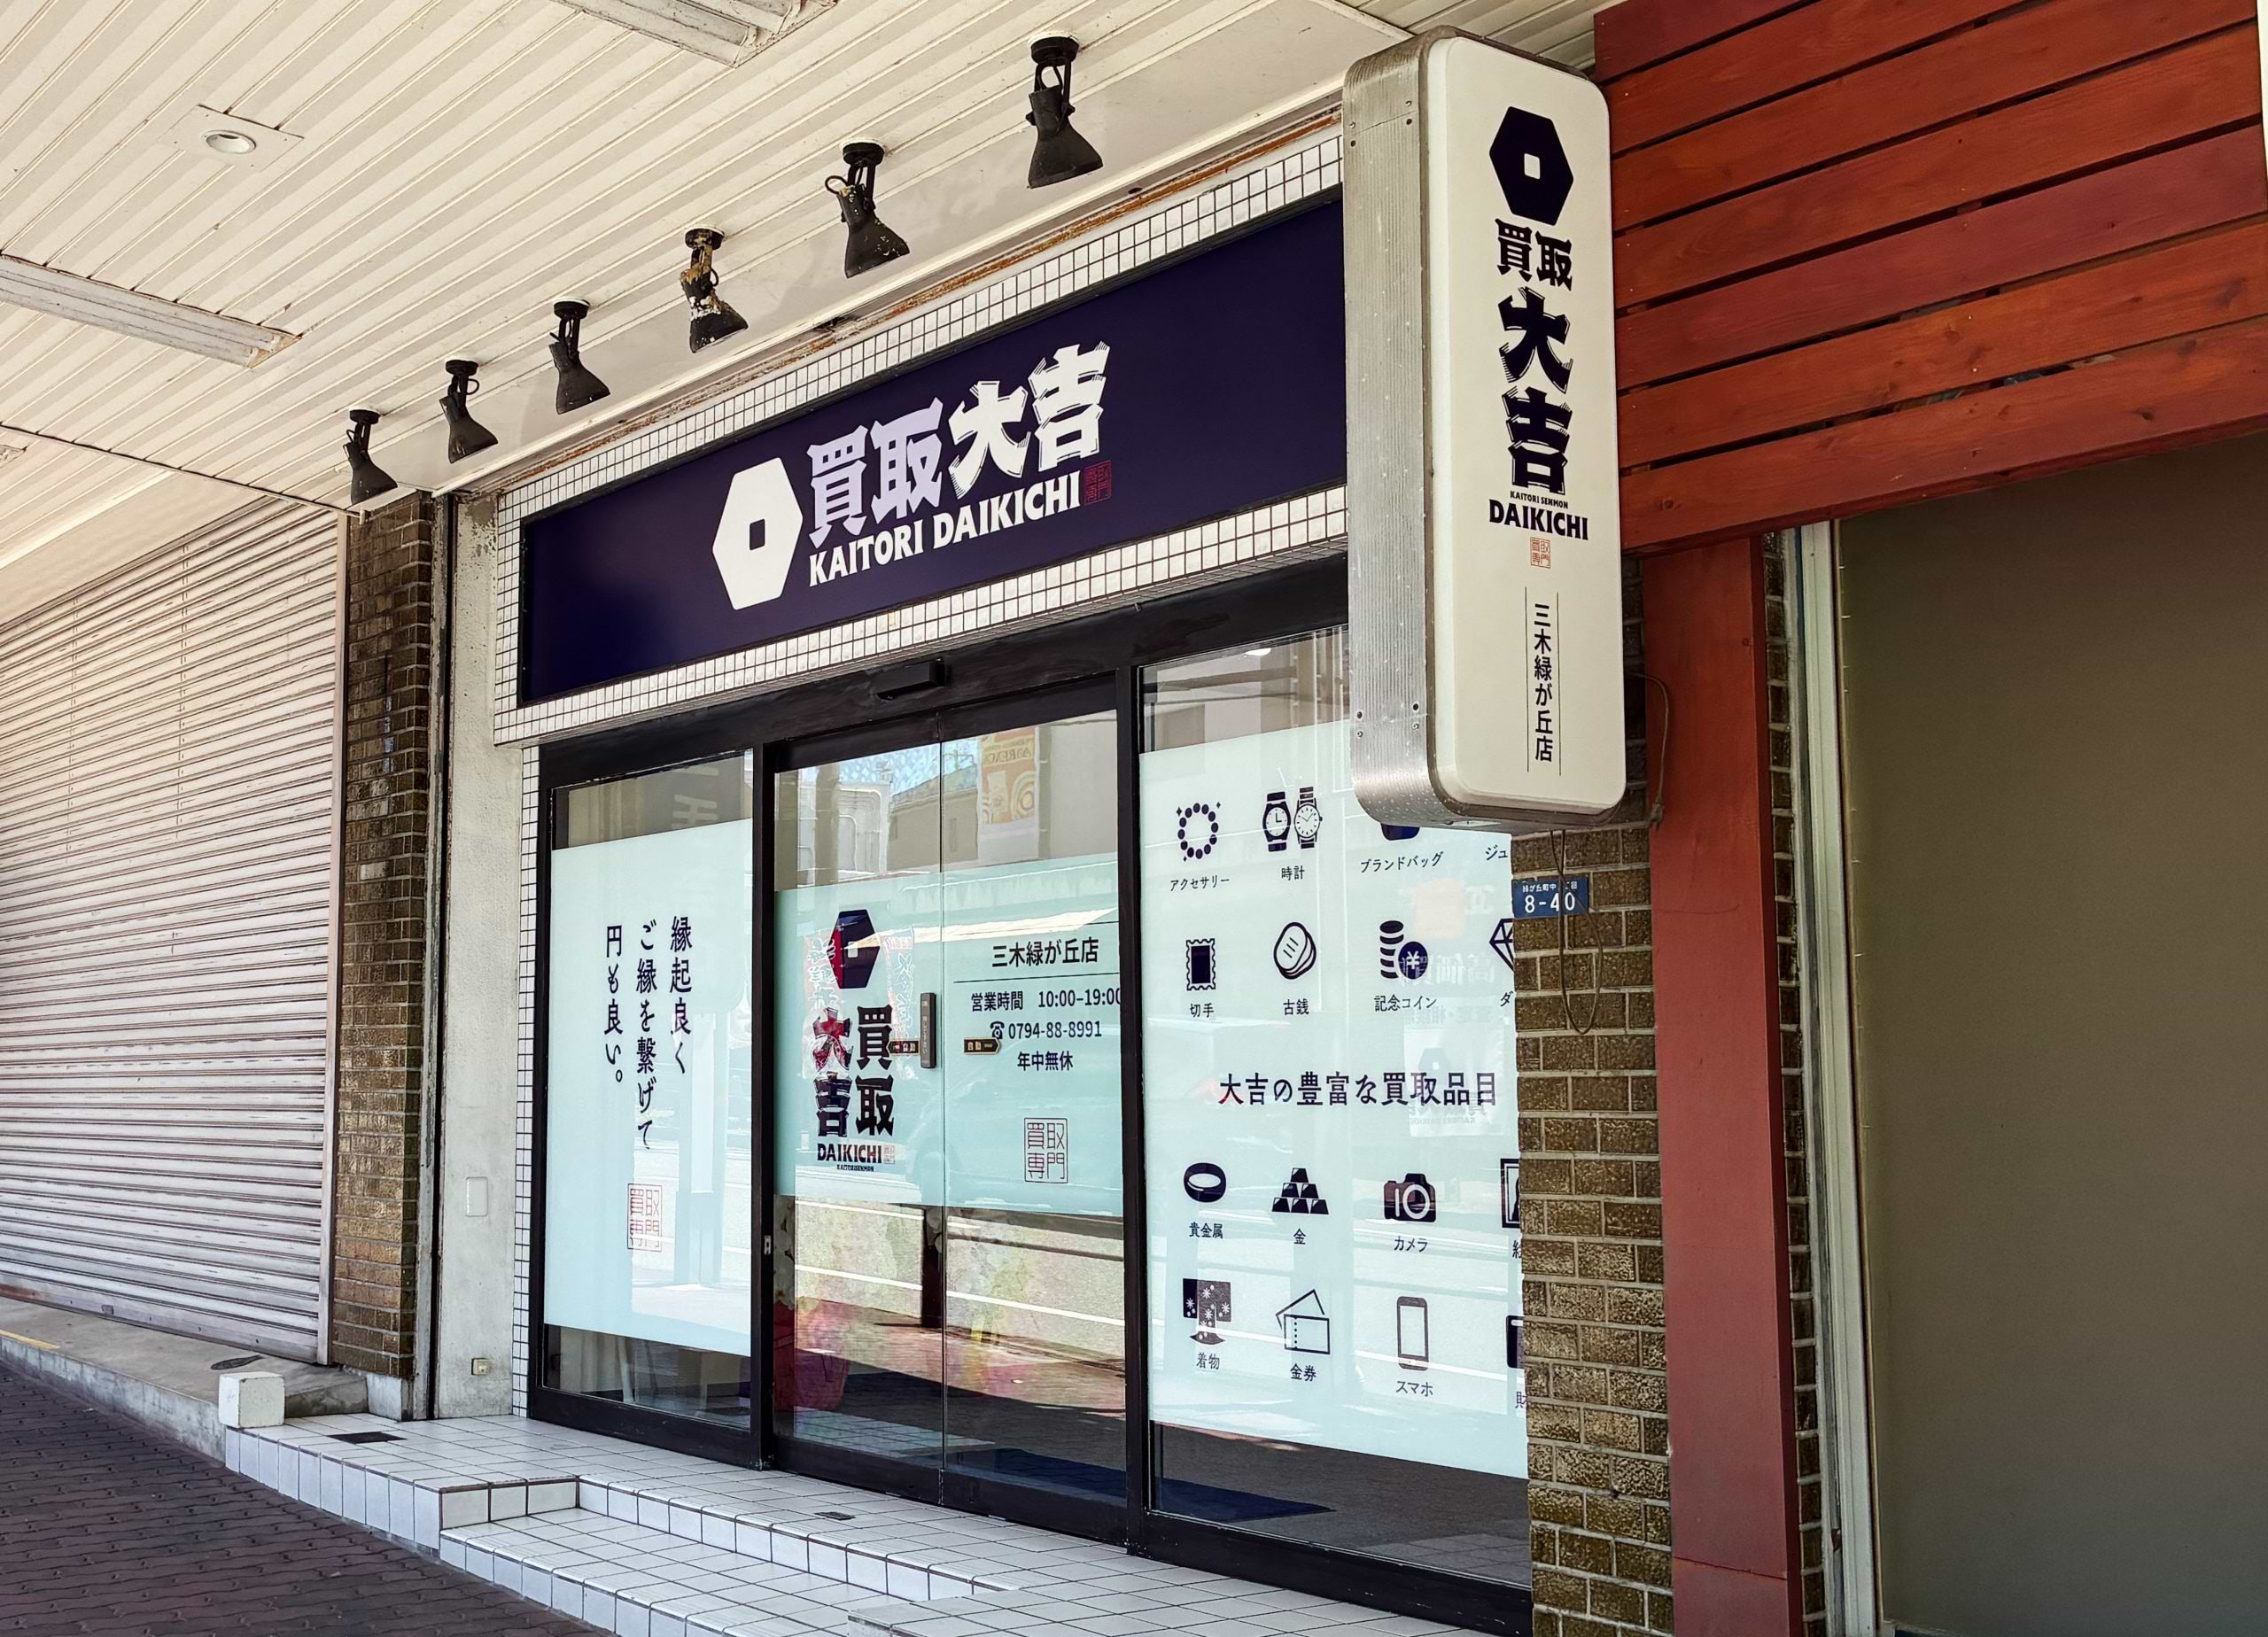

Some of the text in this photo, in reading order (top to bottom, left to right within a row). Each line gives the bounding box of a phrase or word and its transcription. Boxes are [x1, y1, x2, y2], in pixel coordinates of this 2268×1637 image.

[1495, 218, 1573, 291] 買取
[1497, 286, 1573, 496] 大吉
[806, 341, 1111, 549] 買取大吉
[1510, 490, 1569, 509] KAITORI SENMON
[809, 470, 1081, 587] KAITORI DAIKICHI
[1488, 498, 1588, 541] DAIKICHI
[1534, 603, 1553, 763] 三木緑が丘店
[1360, 850, 1444, 873] ブランドバッグ
[1485, 844, 1509, 861] ジュ
[1170, 875, 1230, 892] アクセサリー
[1281, 865, 1305, 881] 時計
[1525, 891, 1576, 913] 8-40
[991, 936, 1099, 968] 三木緑が丘店
[603, 925, 624, 1082] 円も良い。
[669, 915, 693, 1075] 縁起良く
[971, 990, 1023, 1012] 営業時間
[1373, 994, 1437, 1012] 記念コイン
[1500, 990, 1513, 1007] ダ
[1189, 1002, 1215, 1019] 切手
[1282, 997, 1309, 1016] 古銭
[636, 919, 657, 1150] ご縁を繋げて
[1008, 1020, 1103, 1040] 0794-88-8991
[812, 1006, 853, 1138] 大吉
[855, 1004, 895, 1137] 買取
[1017, 1050, 1074, 1072] 年中無休
[1218, 1070, 1496, 1106] 大吉の豊富な買取品目
[1027, 1122, 1065, 1150] 買取
[817, 1143, 882, 1164] DAIKICHI
[1189, 1222, 1223, 1239] 貴金属
[1293, 1228, 1307, 1245] 金
[1394, 1236, 1428, 1253] カメラ
[1196, 1352, 1220, 1370] 着物
[1289, 1362, 1317, 1382] 金券
[1395, 1380, 1433, 1397] スマホ
